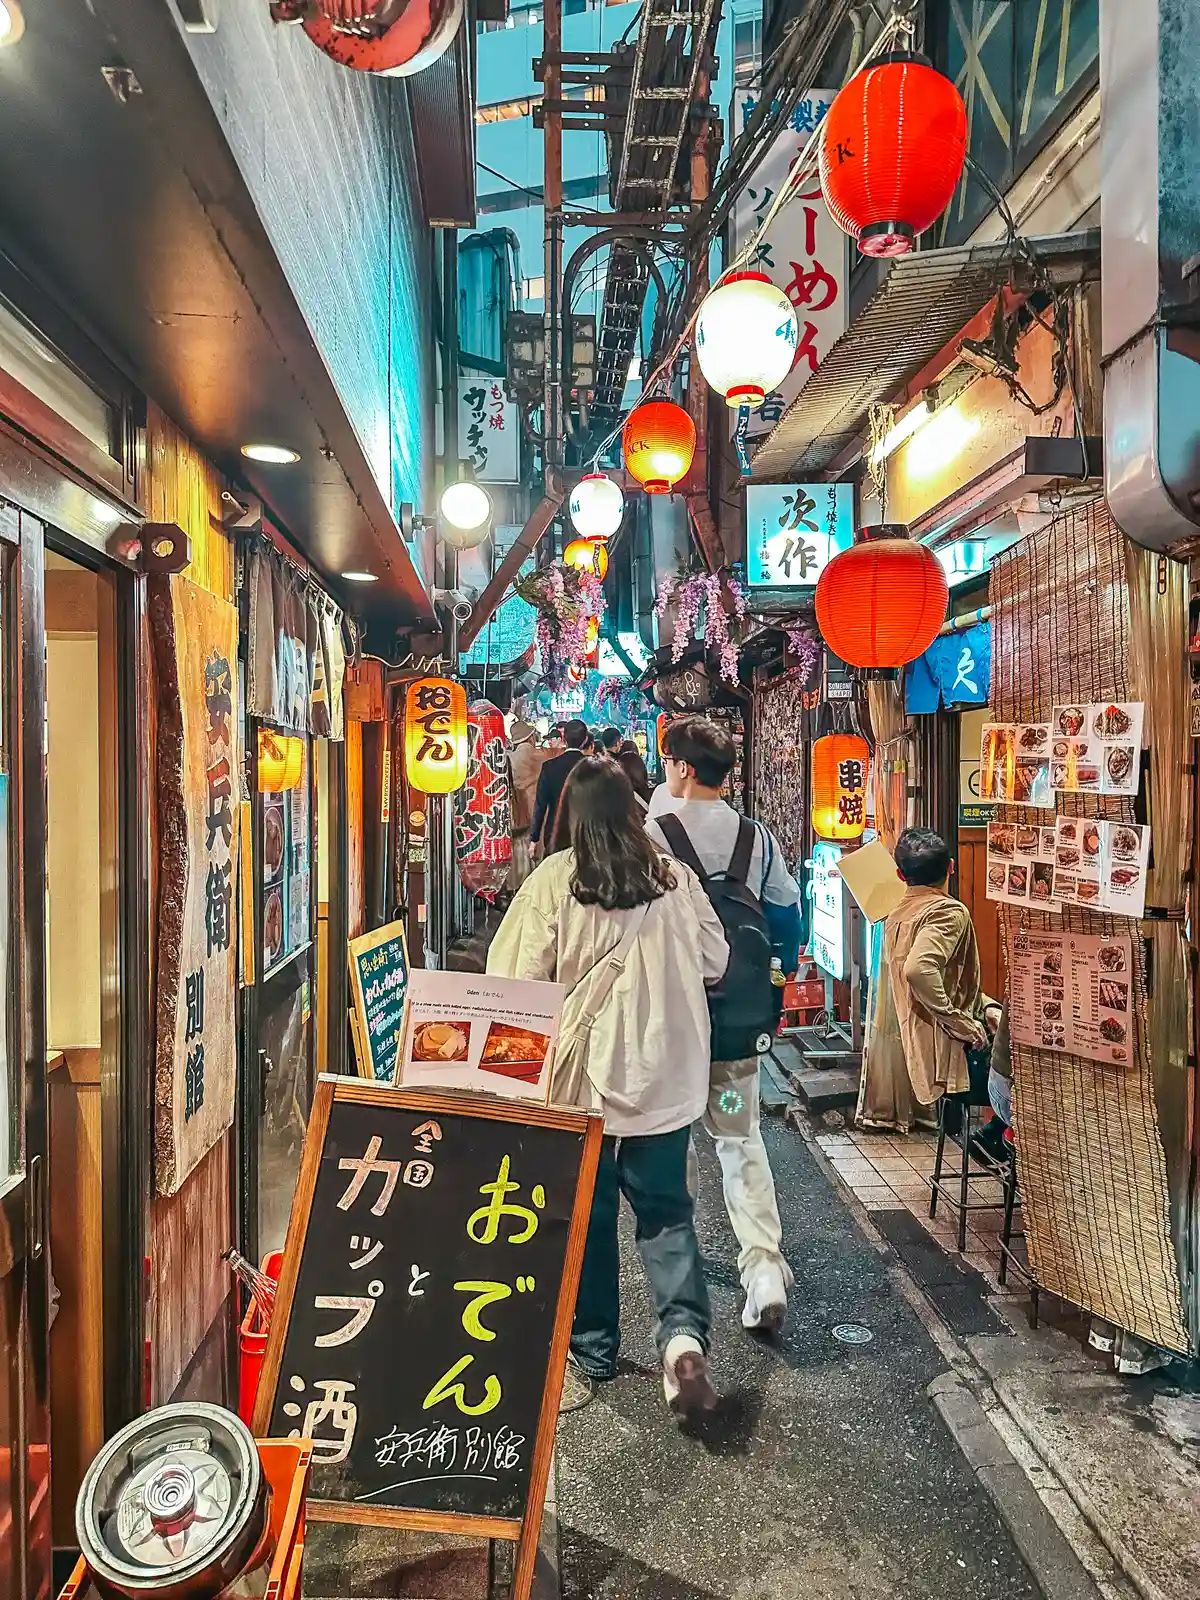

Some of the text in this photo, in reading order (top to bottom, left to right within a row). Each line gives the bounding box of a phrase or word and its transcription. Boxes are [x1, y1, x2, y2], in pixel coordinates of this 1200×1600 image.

[463, 387, 488, 474] ウッチャン
[489, 384, 505, 431] もつ焼
[778, 488, 820, 579] 次作
[826, 488, 838, 536] もつ焼き
[415, 685, 454, 761] おでん
[482, 737, 512, 839] もつ焼
[839, 760, 863, 825] 串焼
[403, 1120, 442, 1188] 全国
[281, 1135, 401, 1464] カップ酒
[408, 1264, 431, 1297] と
[422, 1154, 546, 1416] おでん
